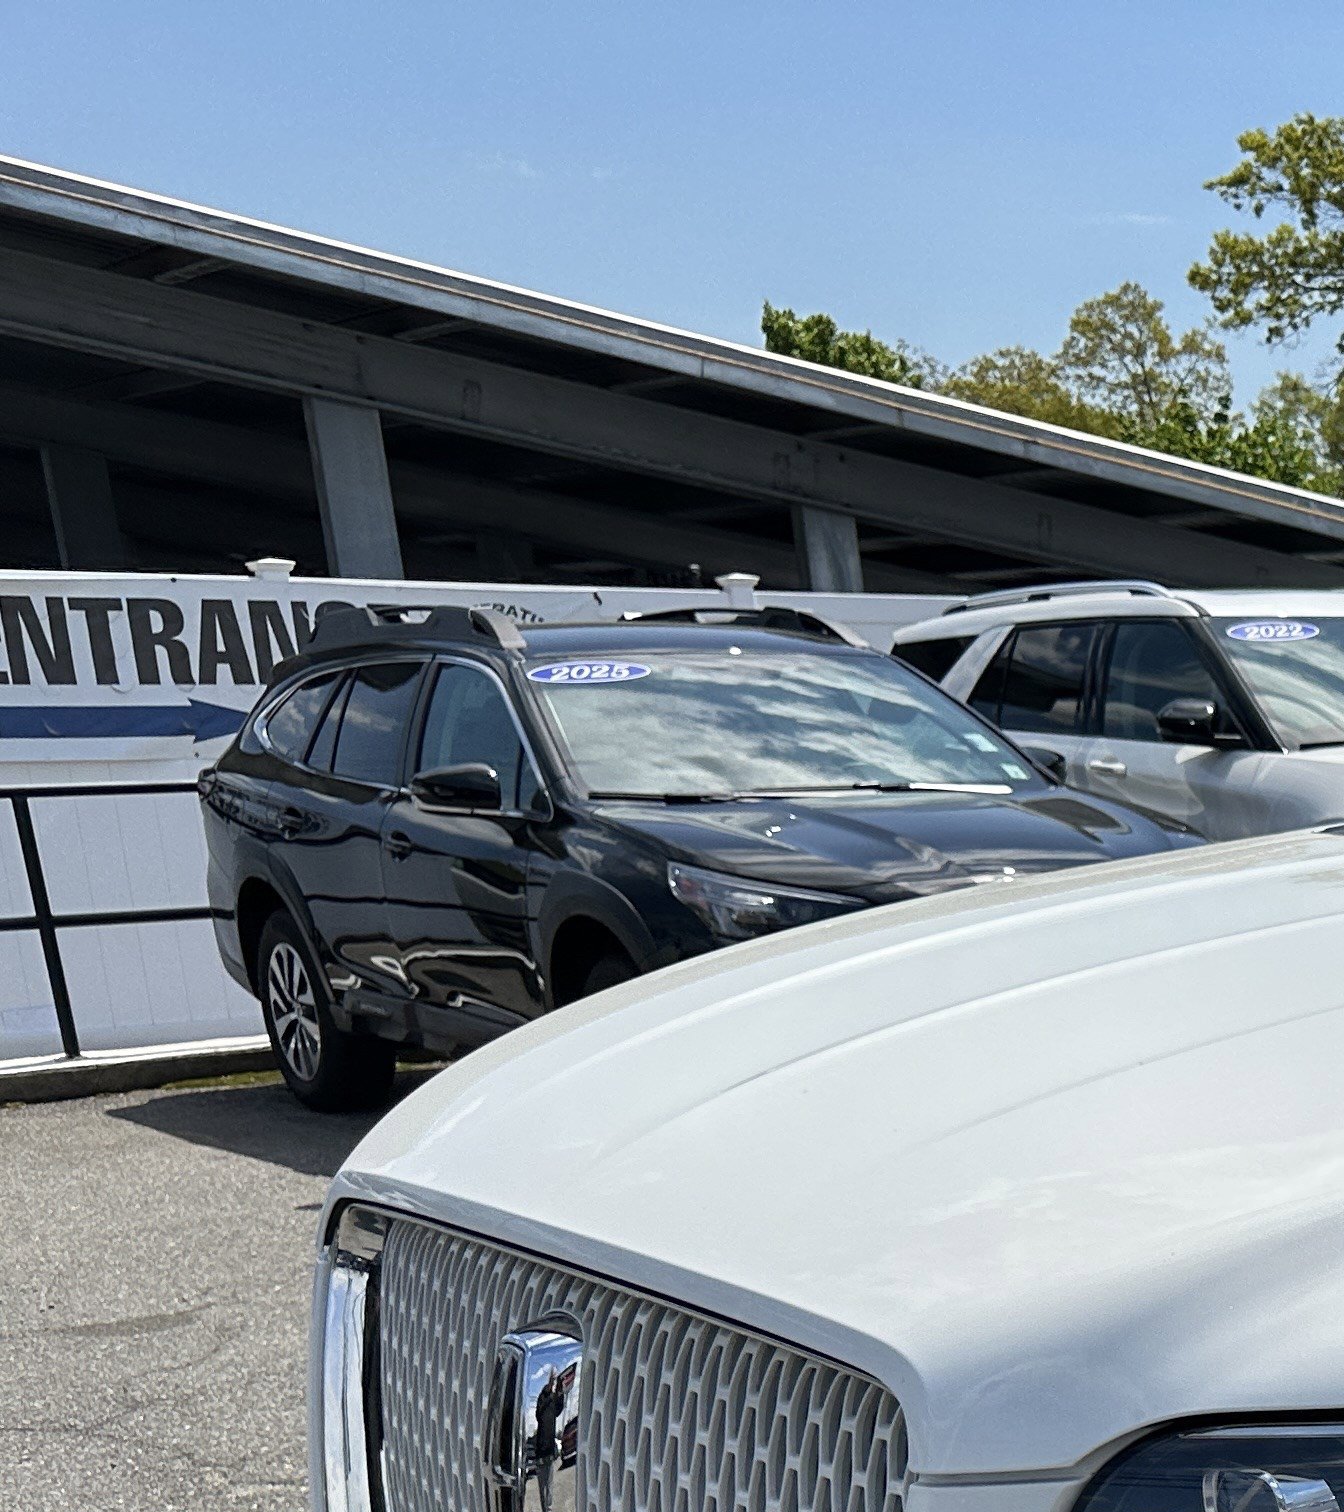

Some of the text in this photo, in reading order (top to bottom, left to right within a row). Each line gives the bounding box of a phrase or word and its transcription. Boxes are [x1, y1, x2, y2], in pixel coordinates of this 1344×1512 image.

[1244, 623, 1305, 640] 2022
[0, 595, 361, 686] NTRAN
[550, 664, 630, 681] 2025
